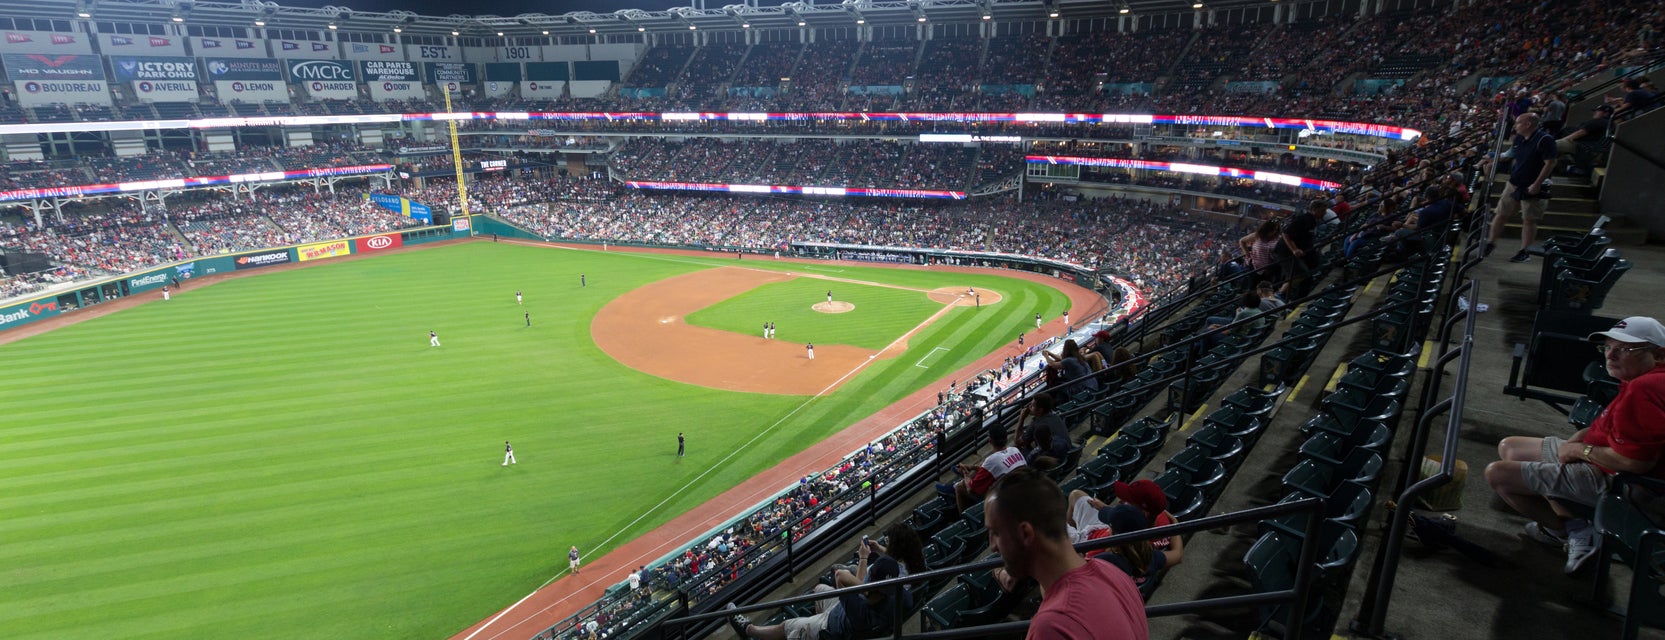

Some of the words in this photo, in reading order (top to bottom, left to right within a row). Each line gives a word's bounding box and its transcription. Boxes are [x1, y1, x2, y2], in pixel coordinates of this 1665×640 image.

[420, 46, 451, 58] EST.
[505, 47, 530, 59] 1901
[366, 67, 415, 75] WAREHOUSE
[42, 83, 101, 92] BOUDREAU
[155, 83, 194, 91] AVERILL
[245, 83, 274, 91] LEMON
[372, 238, 388, 247] KIA
[0, 308, 30, 324] Bank
